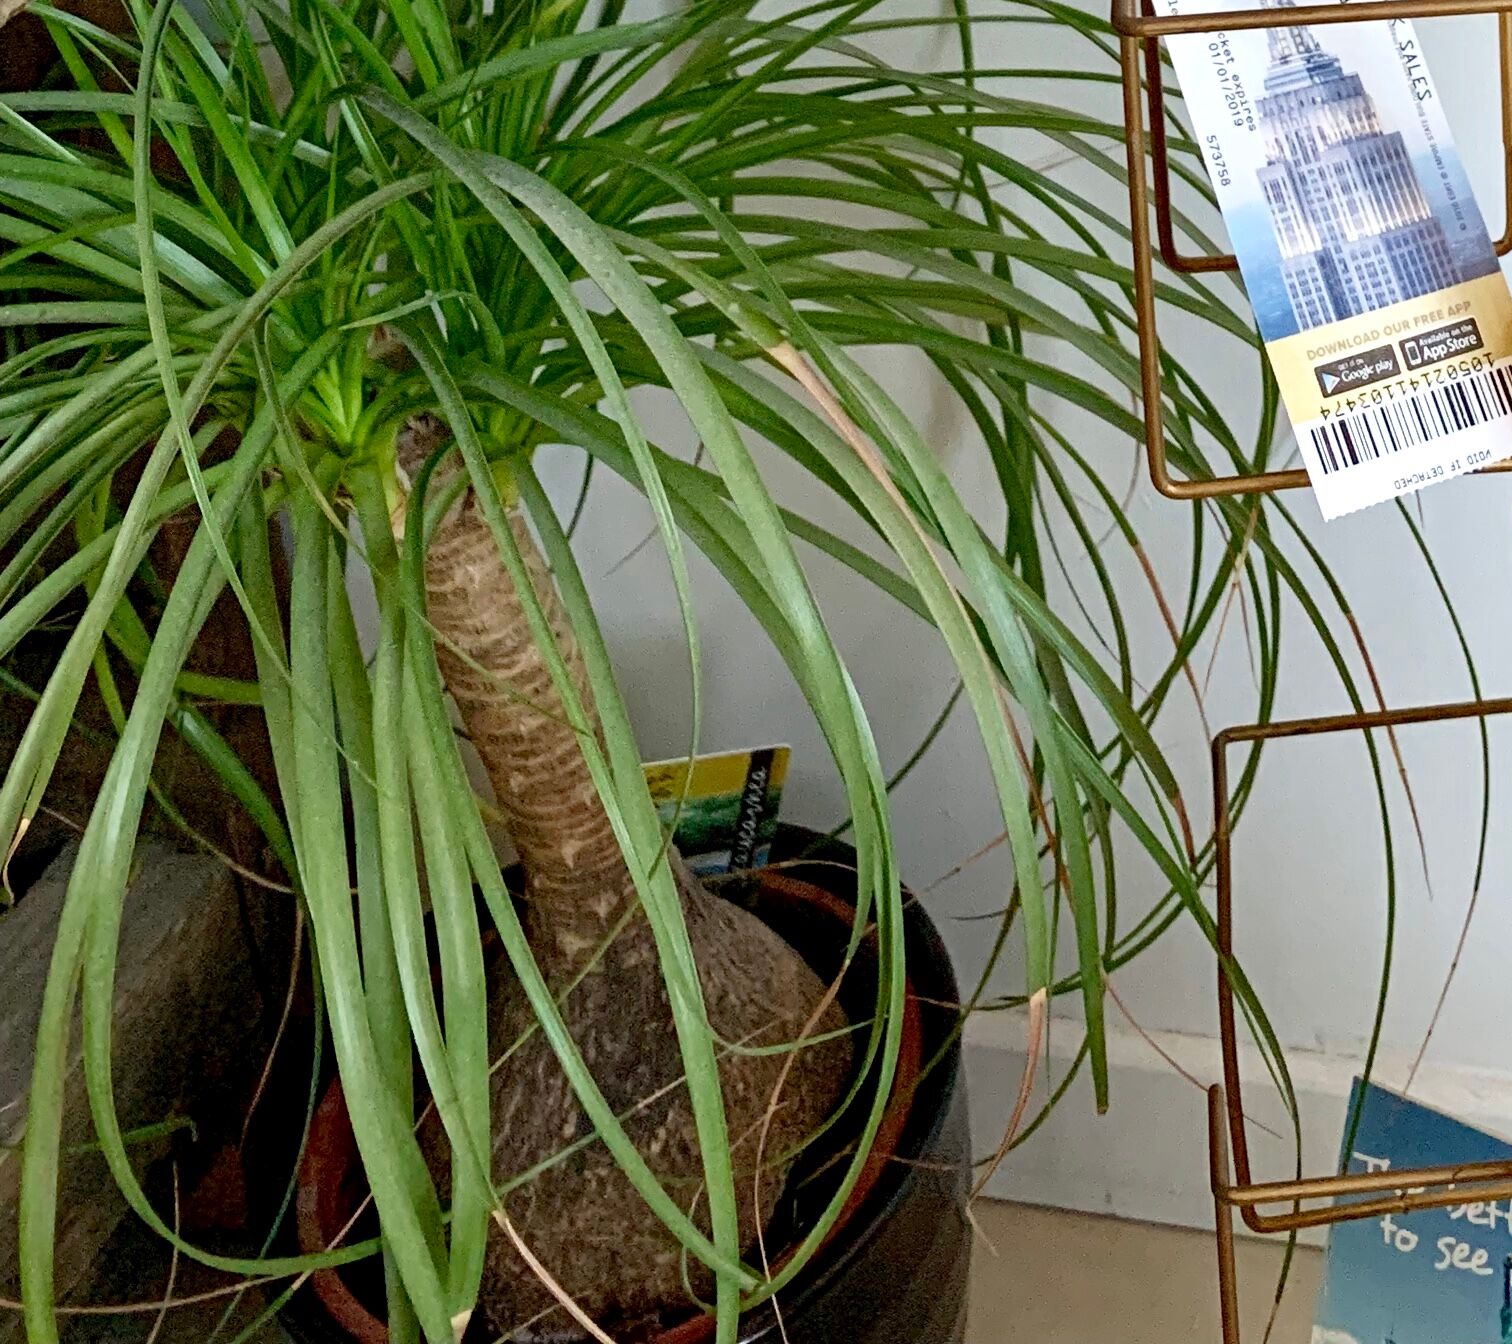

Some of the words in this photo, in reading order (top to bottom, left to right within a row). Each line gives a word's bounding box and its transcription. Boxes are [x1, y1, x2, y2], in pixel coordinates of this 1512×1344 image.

[1205, 41, 1245, 128] 01/01/2019
[1216, 30, 1236, 65] cket
[1228, 72, 1259, 133] expires
[1397, 38, 1433, 103] SALES
[1204, 133, 1232, 188] 573758
[1305, 328, 1381, 361] DOWNLOAD
[1381, 318, 1411, 337] OUR
[1412, 308, 1445, 328] FREE
[1445, 299, 1473, 317] APP
[1420, 339, 1449, 364] App
[1444, 329, 1478, 353] Store
[1318, 350, 1497, 422] 10502141103474
[1339, 360, 1378, 387] Google
[1372, 355, 1395, 375] play
[1394, 466, 1444, 490] DETACHED
[1450, 459, 1462, 473] IF
[1467, 448, 1492, 466] VOID
[1380, 1213, 1419, 1253] to
[1434, 1236, 1494, 1276] see
